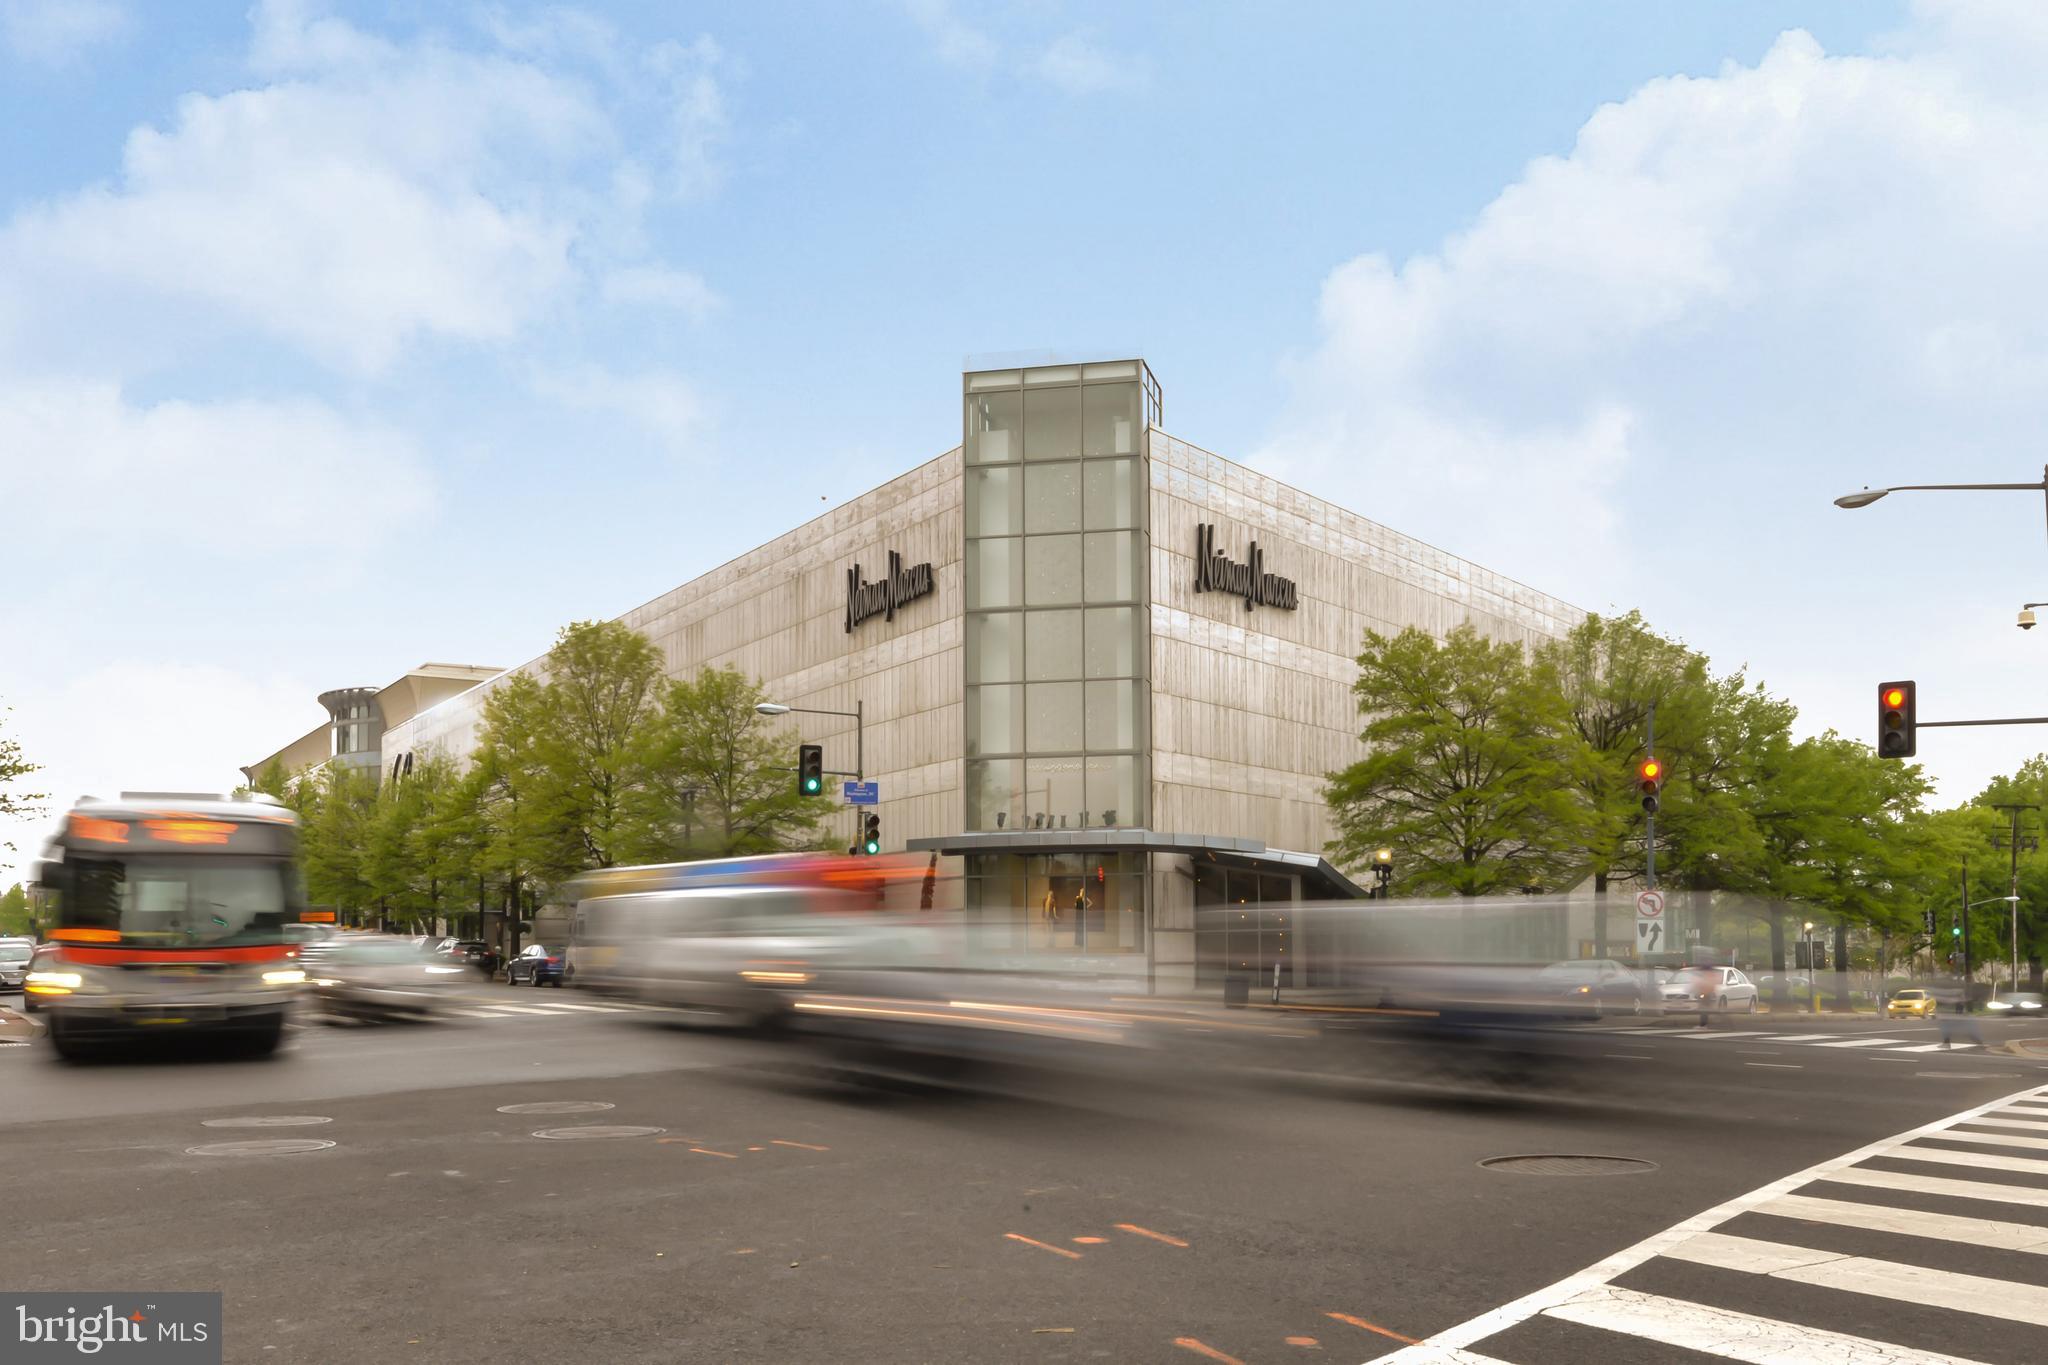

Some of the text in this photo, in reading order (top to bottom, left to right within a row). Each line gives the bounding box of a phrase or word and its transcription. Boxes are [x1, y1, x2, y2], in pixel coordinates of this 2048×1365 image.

[844, 550, 933, 634] Neiman Marcus
[1195, 523, 1299, 612] Neiman Marcus
